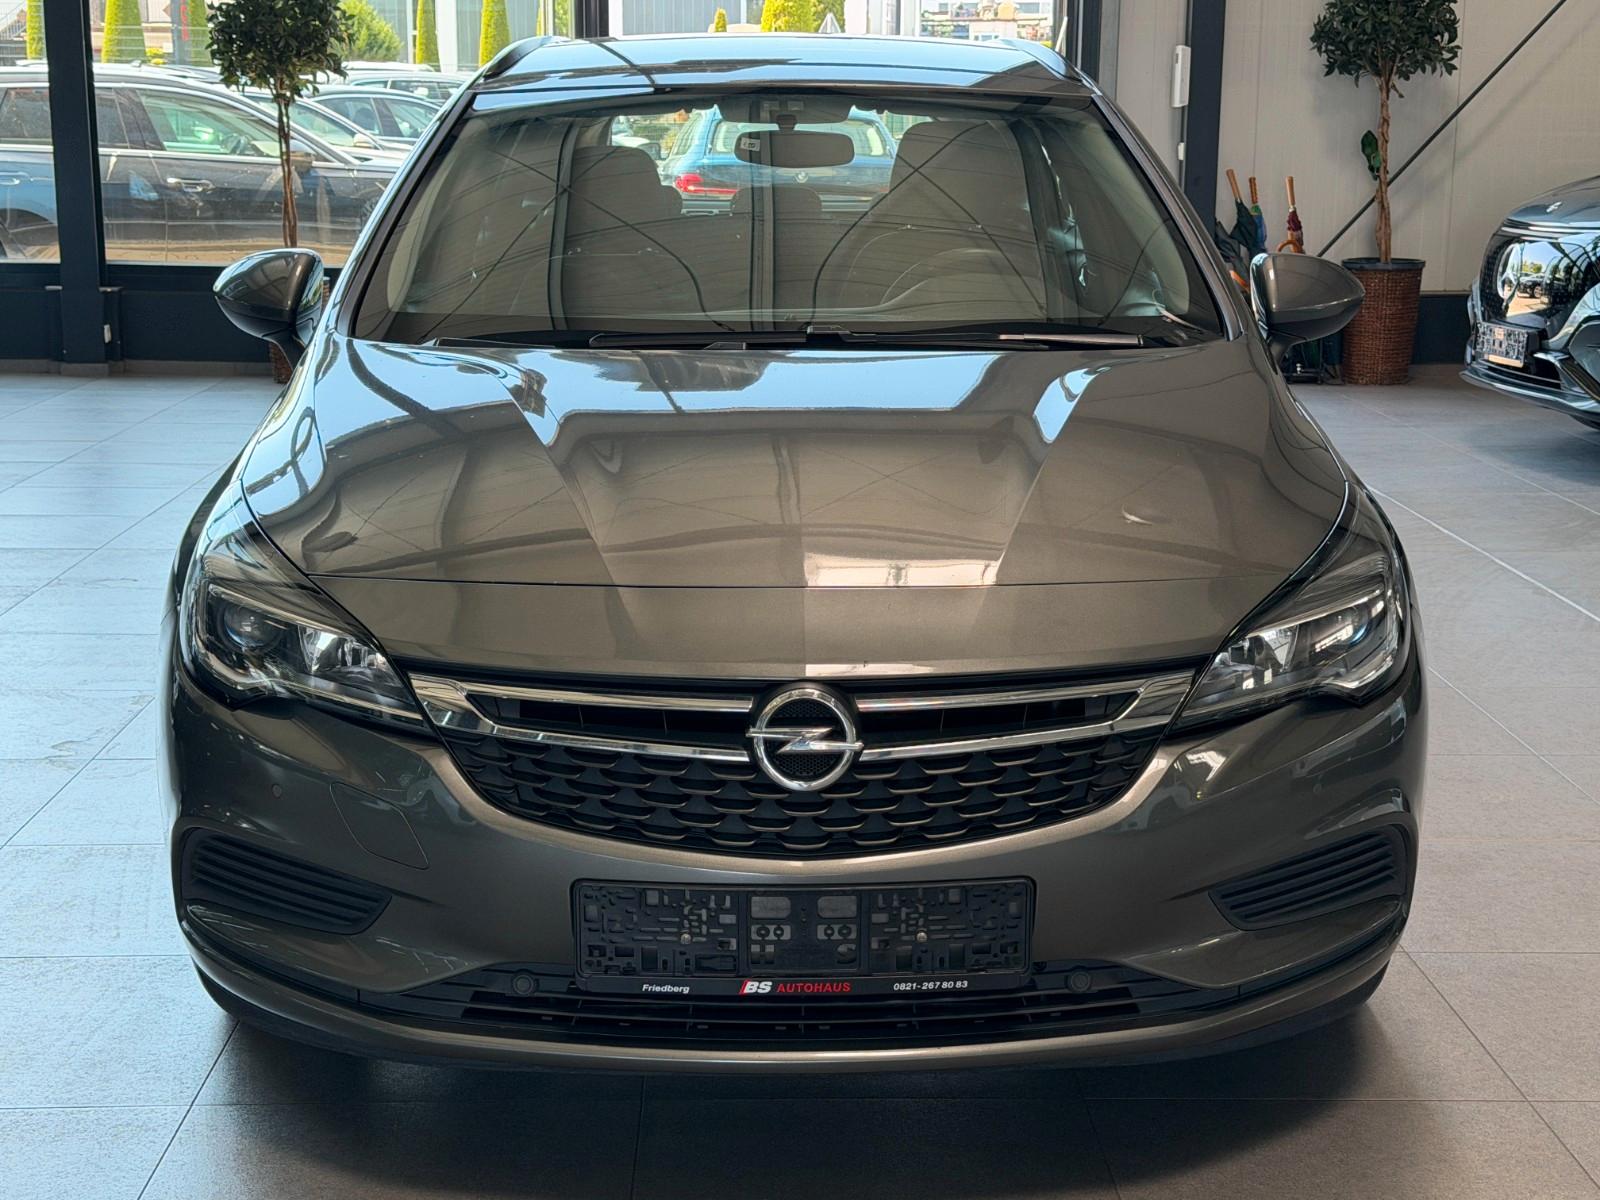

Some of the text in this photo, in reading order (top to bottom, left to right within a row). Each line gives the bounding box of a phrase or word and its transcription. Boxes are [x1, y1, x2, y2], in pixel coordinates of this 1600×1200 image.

[642, 983, 690, 994] Friedberg
[743, 981, 851, 993] BS AUTOHAUS
[955, 980, 968, 988] 83
